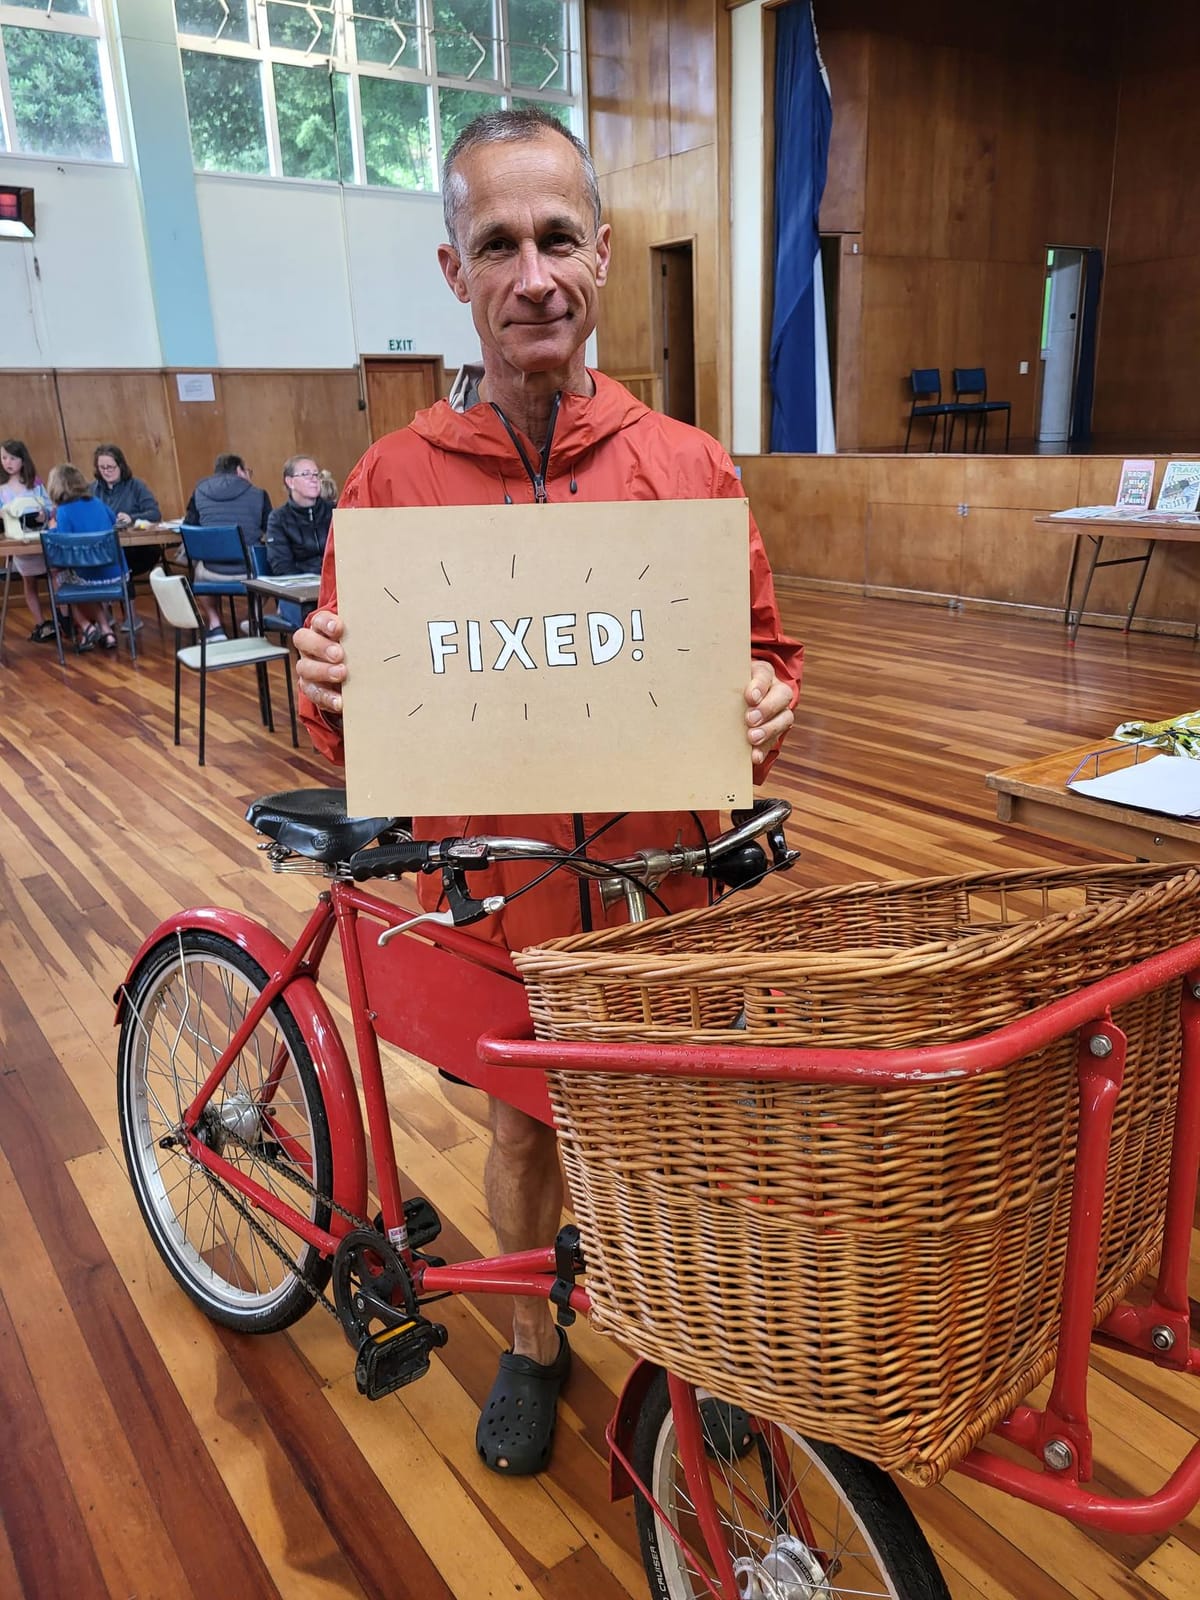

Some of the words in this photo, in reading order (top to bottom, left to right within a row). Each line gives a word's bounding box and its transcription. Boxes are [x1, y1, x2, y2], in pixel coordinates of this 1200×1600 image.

[389, 339, 413, 351] EXIT
[427, 609, 645, 674] FIXED!
[650, 1545, 667, 1592] CRUISER
